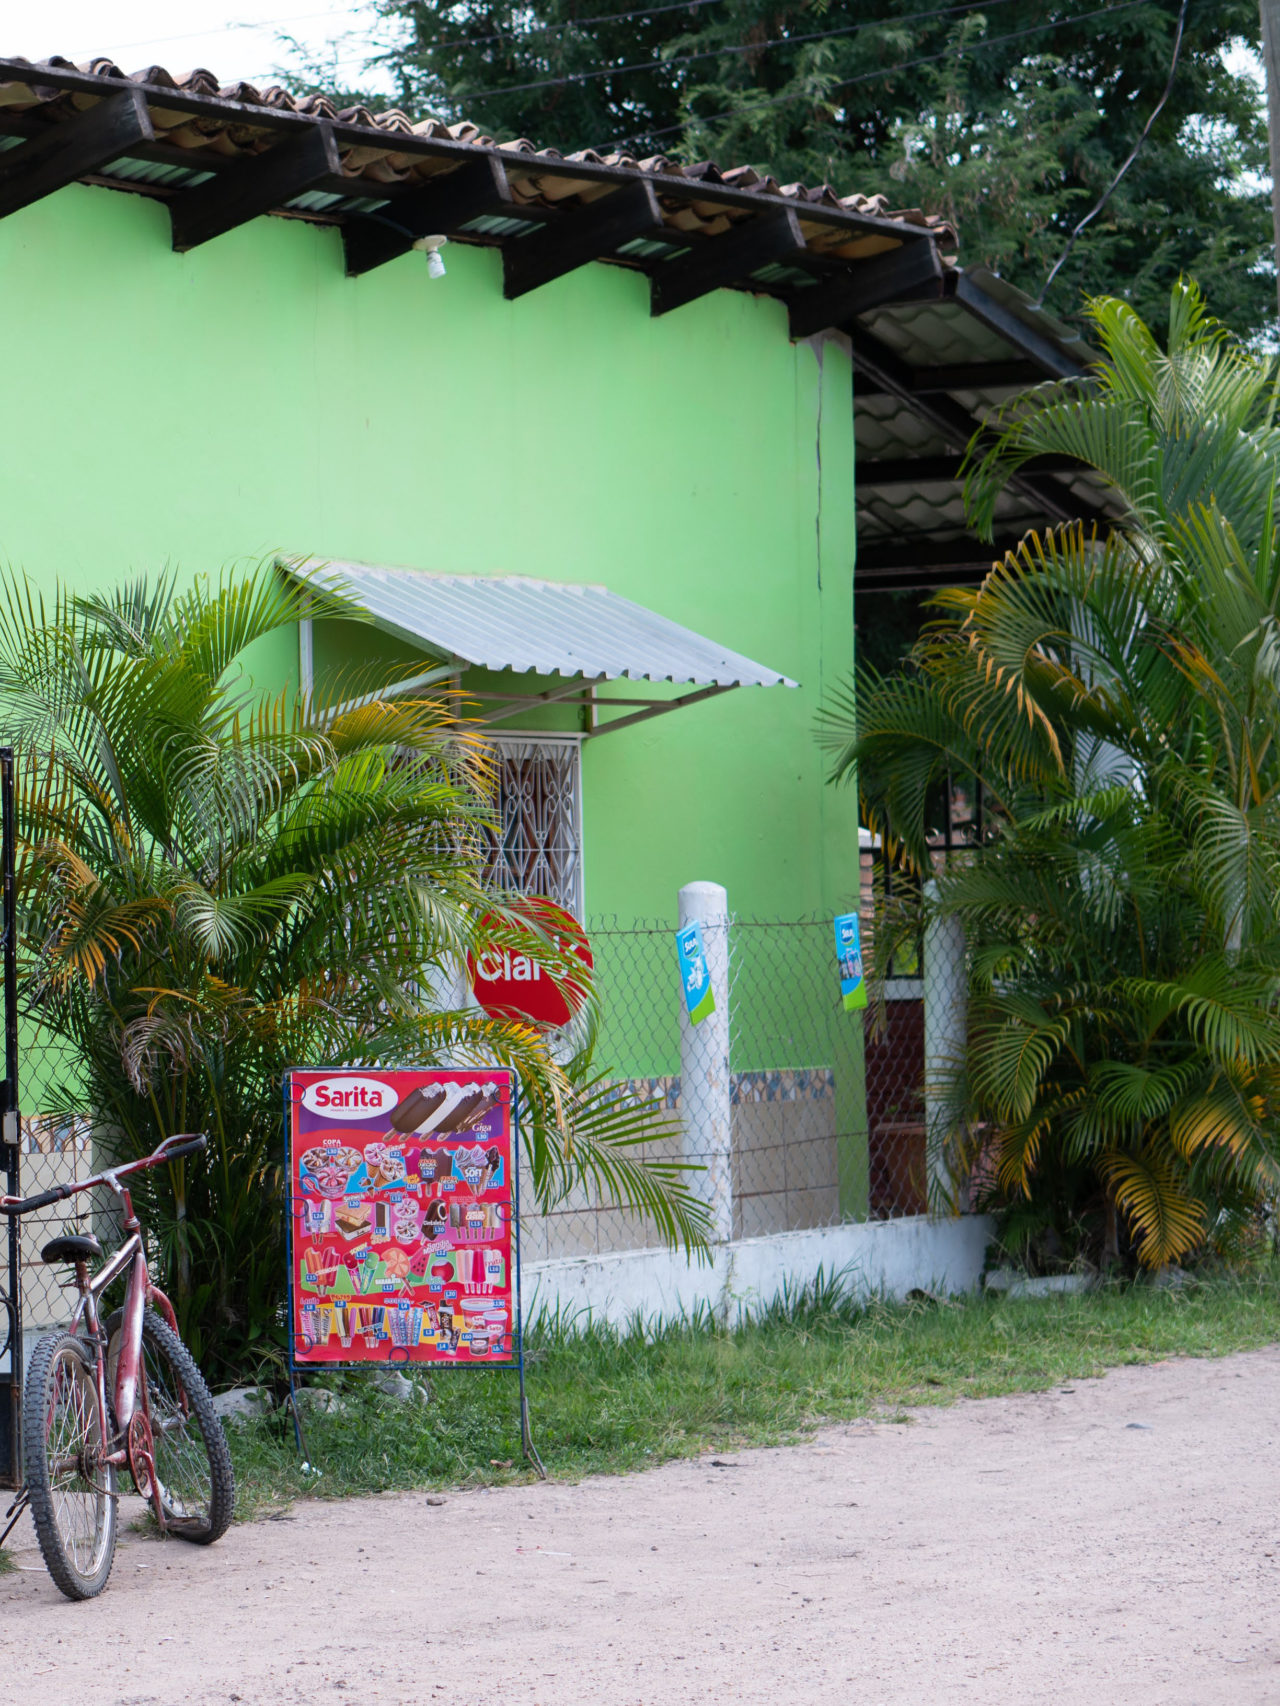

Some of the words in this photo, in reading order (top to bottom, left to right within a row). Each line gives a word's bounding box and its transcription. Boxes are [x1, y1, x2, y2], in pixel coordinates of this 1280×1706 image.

[315, 1085, 383, 1107] Sarita
[471, 1123, 492, 1134] Giga
[464, 1168, 482, 1178] SOFT
